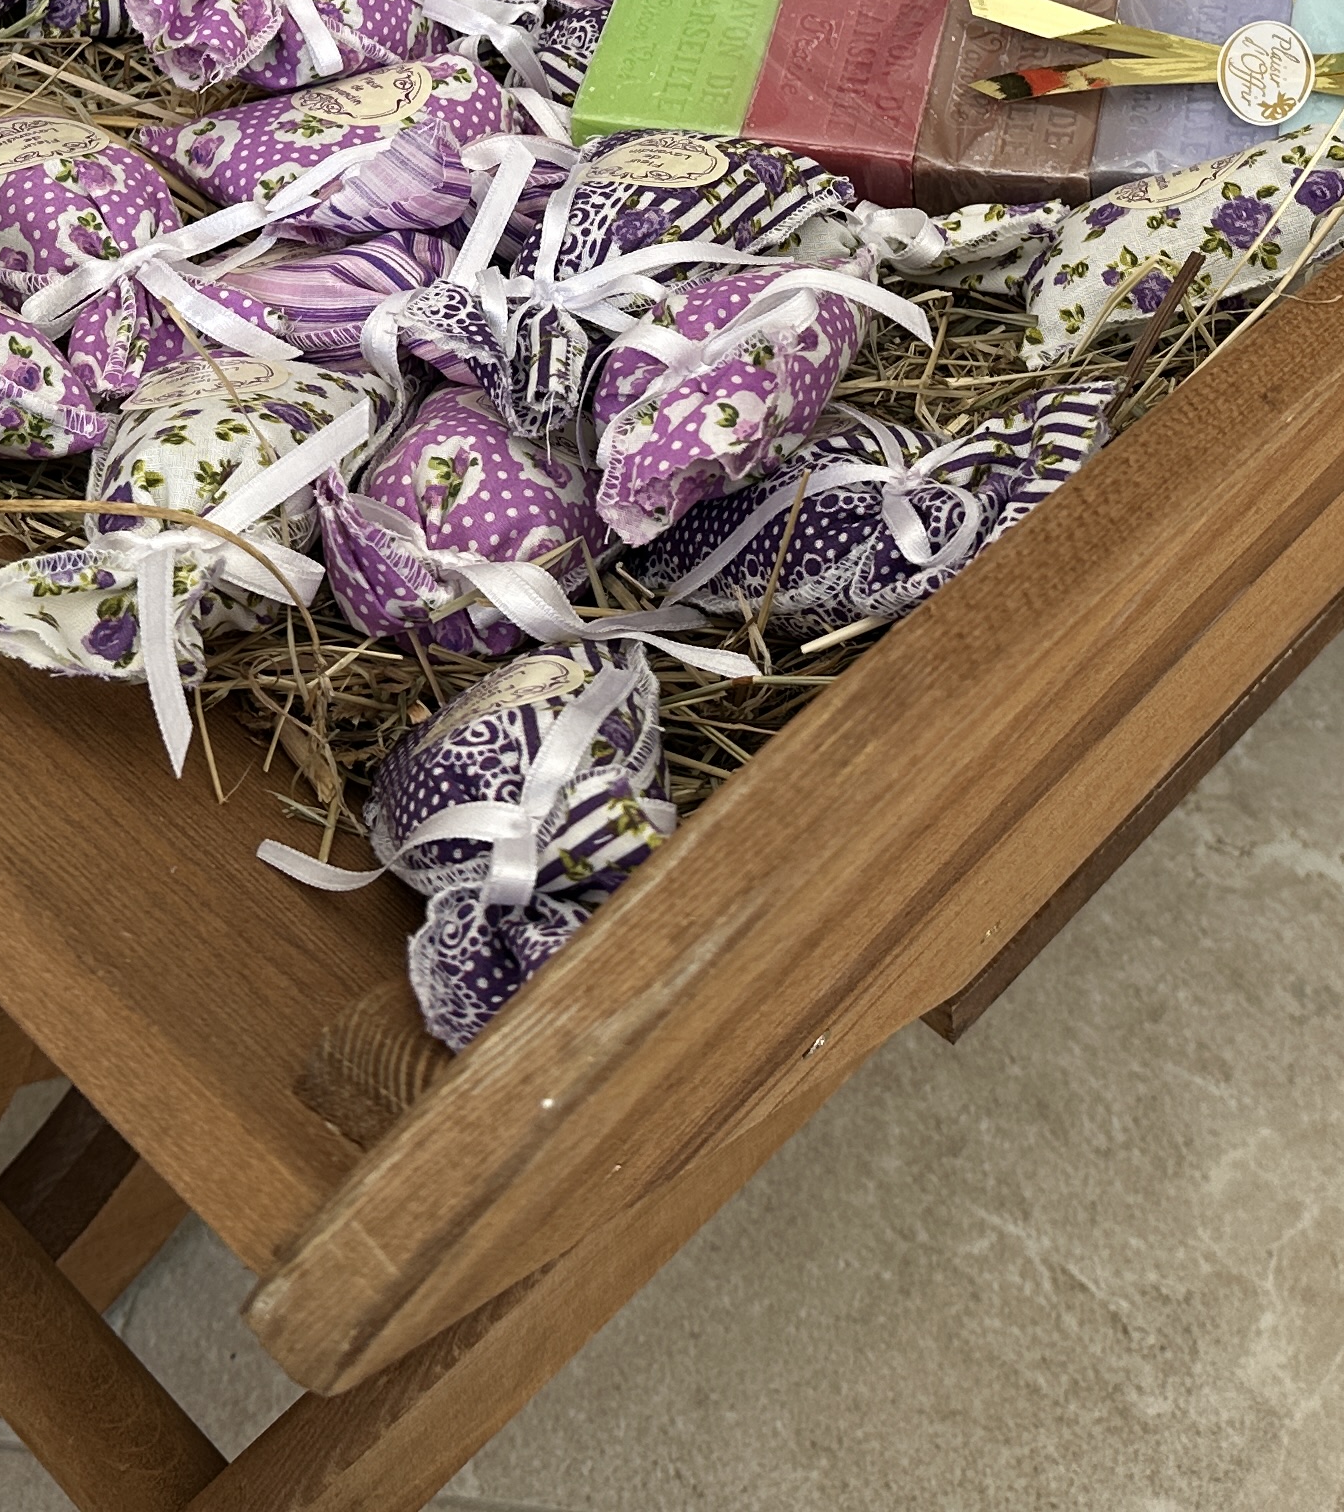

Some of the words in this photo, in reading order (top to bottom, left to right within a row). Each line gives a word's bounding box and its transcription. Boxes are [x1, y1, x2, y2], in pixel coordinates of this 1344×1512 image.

[1269, 32, 1301, 89] Plaisir
[1228, 35, 1270, 107] d'Offrir
[701, 71, 737, 104] DE
[21, 137, 61, 151] Fleur
[24, 134, 43, 143] de
[628, 147, 693, 161] Lavandin
[624, 158, 665, 169] Fleur
